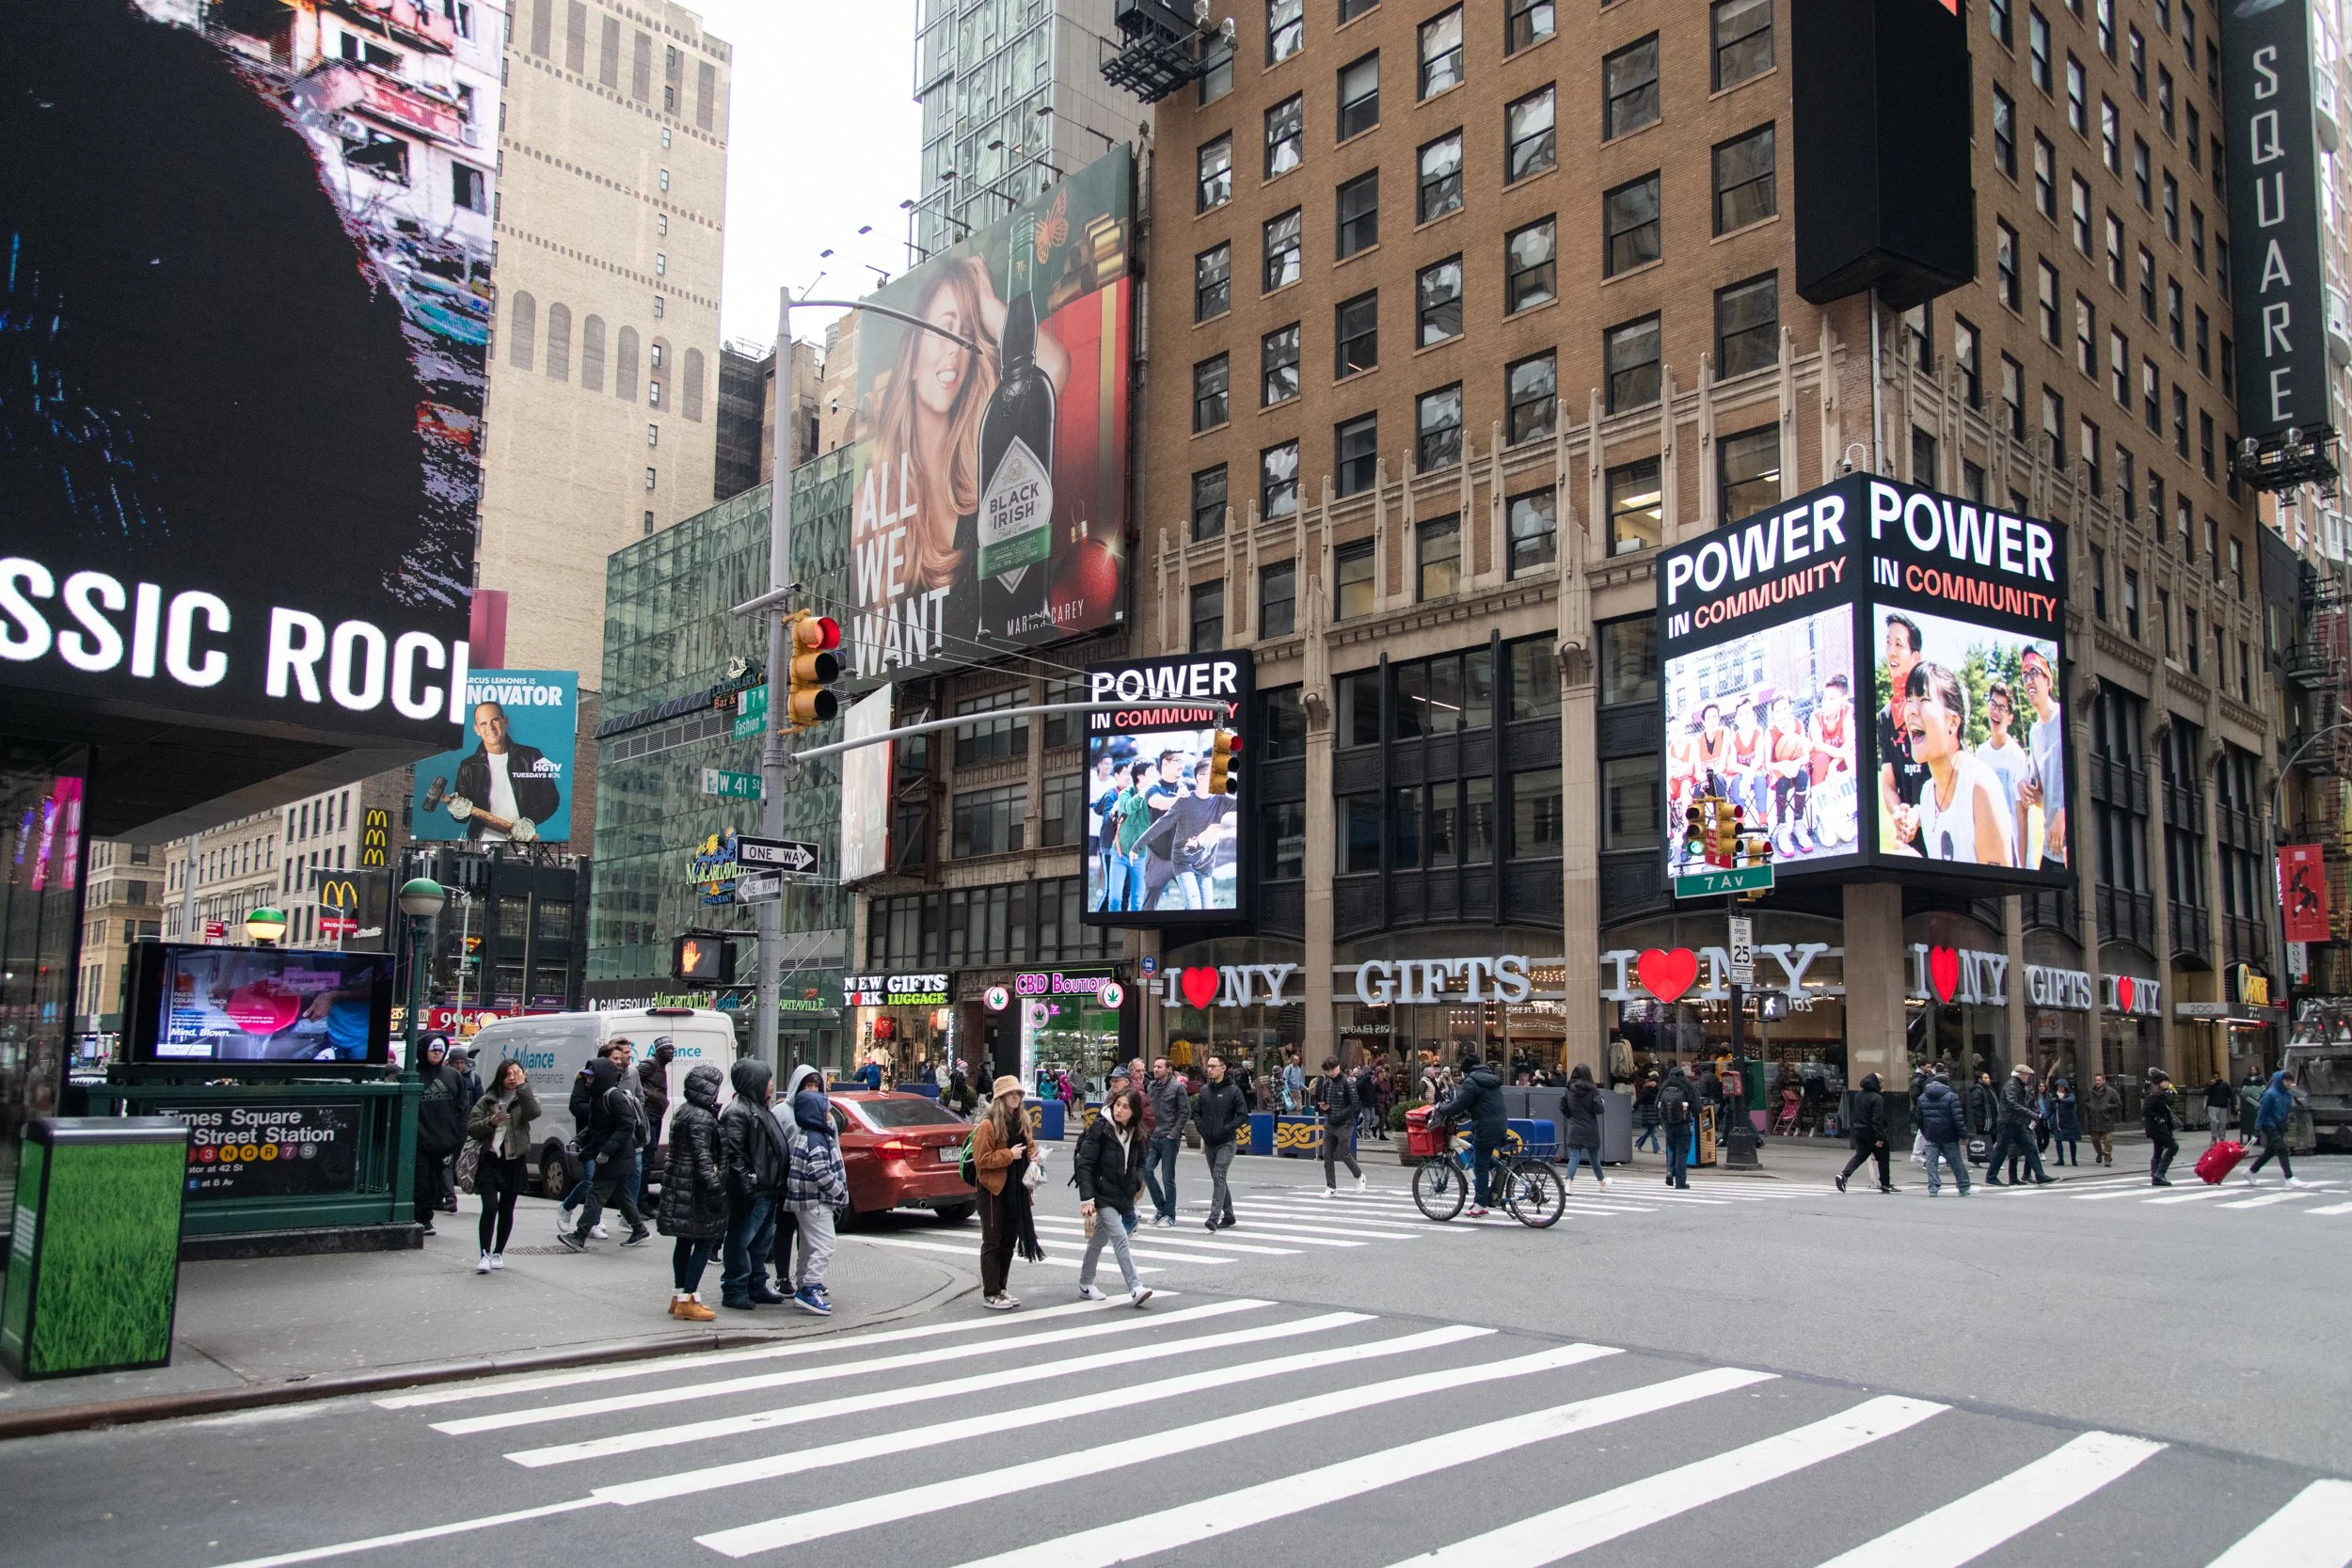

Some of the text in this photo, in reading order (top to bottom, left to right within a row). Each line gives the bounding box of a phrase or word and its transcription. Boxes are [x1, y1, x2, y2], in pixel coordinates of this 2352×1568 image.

[2249, 44, 2294, 423] SQUARE
[858, 451, 917, 538] ALL
[990, 481, 1040, 515] BLACK
[993, 501, 1035, 530] IRISH
[1869, 481, 2056, 582] POWER
[1667, 494, 1847, 606] POWER
[857, 527, 906, 608] WE
[1668, 556, 1847, 640] IN COMMUNITY
[1873, 556, 2057, 623] IN COMMUNITY
[1051, 599, 1084, 625] CAREY
[853, 586, 949, 680] WANT
[712, 673, 757, 697] LANDSHARK
[1091, 661, 1238, 704] POWER
[713, 693, 737, 709] Bar &
[751, 691, 756, 707] 7
[735, 716, 760, 736] Fashion
[1091, 702, 1239, 730] IN COMMUNIY
[532, 762, 563, 772] HGTV
[719, 774, 760, 794] W 41 St
[749, 847, 807, 864] ONE WAY
[742, 879, 777, 895] ONE WAY
[1704, 875, 1743, 890] 7 Av
[1734, 944, 1750, 963] 25
[844, 974, 948, 993] NEW GIFTS
[1016, 974, 1048, 994] CBD
[1219, 963, 1297, 1008] NY
[1356, 954, 1533, 1006] GIFTS
[1958, 948, 2010, 1006] NY
[2026, 965, 2092, 1010] GIFTS
[2132, 976, 2161, 1015] NY
[887, 992, 946, 1006] LUGGAGE
[2190, 1005, 2214, 1013] 200
[170, 1028, 231, 1037] Mind. Blown.
[646, 1044, 702, 1057] Aance
[526, 1071, 564, 1084] aintenance
[421, 1089, 453, 1101] adidas
[230, 1108, 303, 1128] Square
[194, 1126, 335, 1146] Street Station
[233, 1164, 244, 1172] St
[214, 1179, 220, 1187] 8
